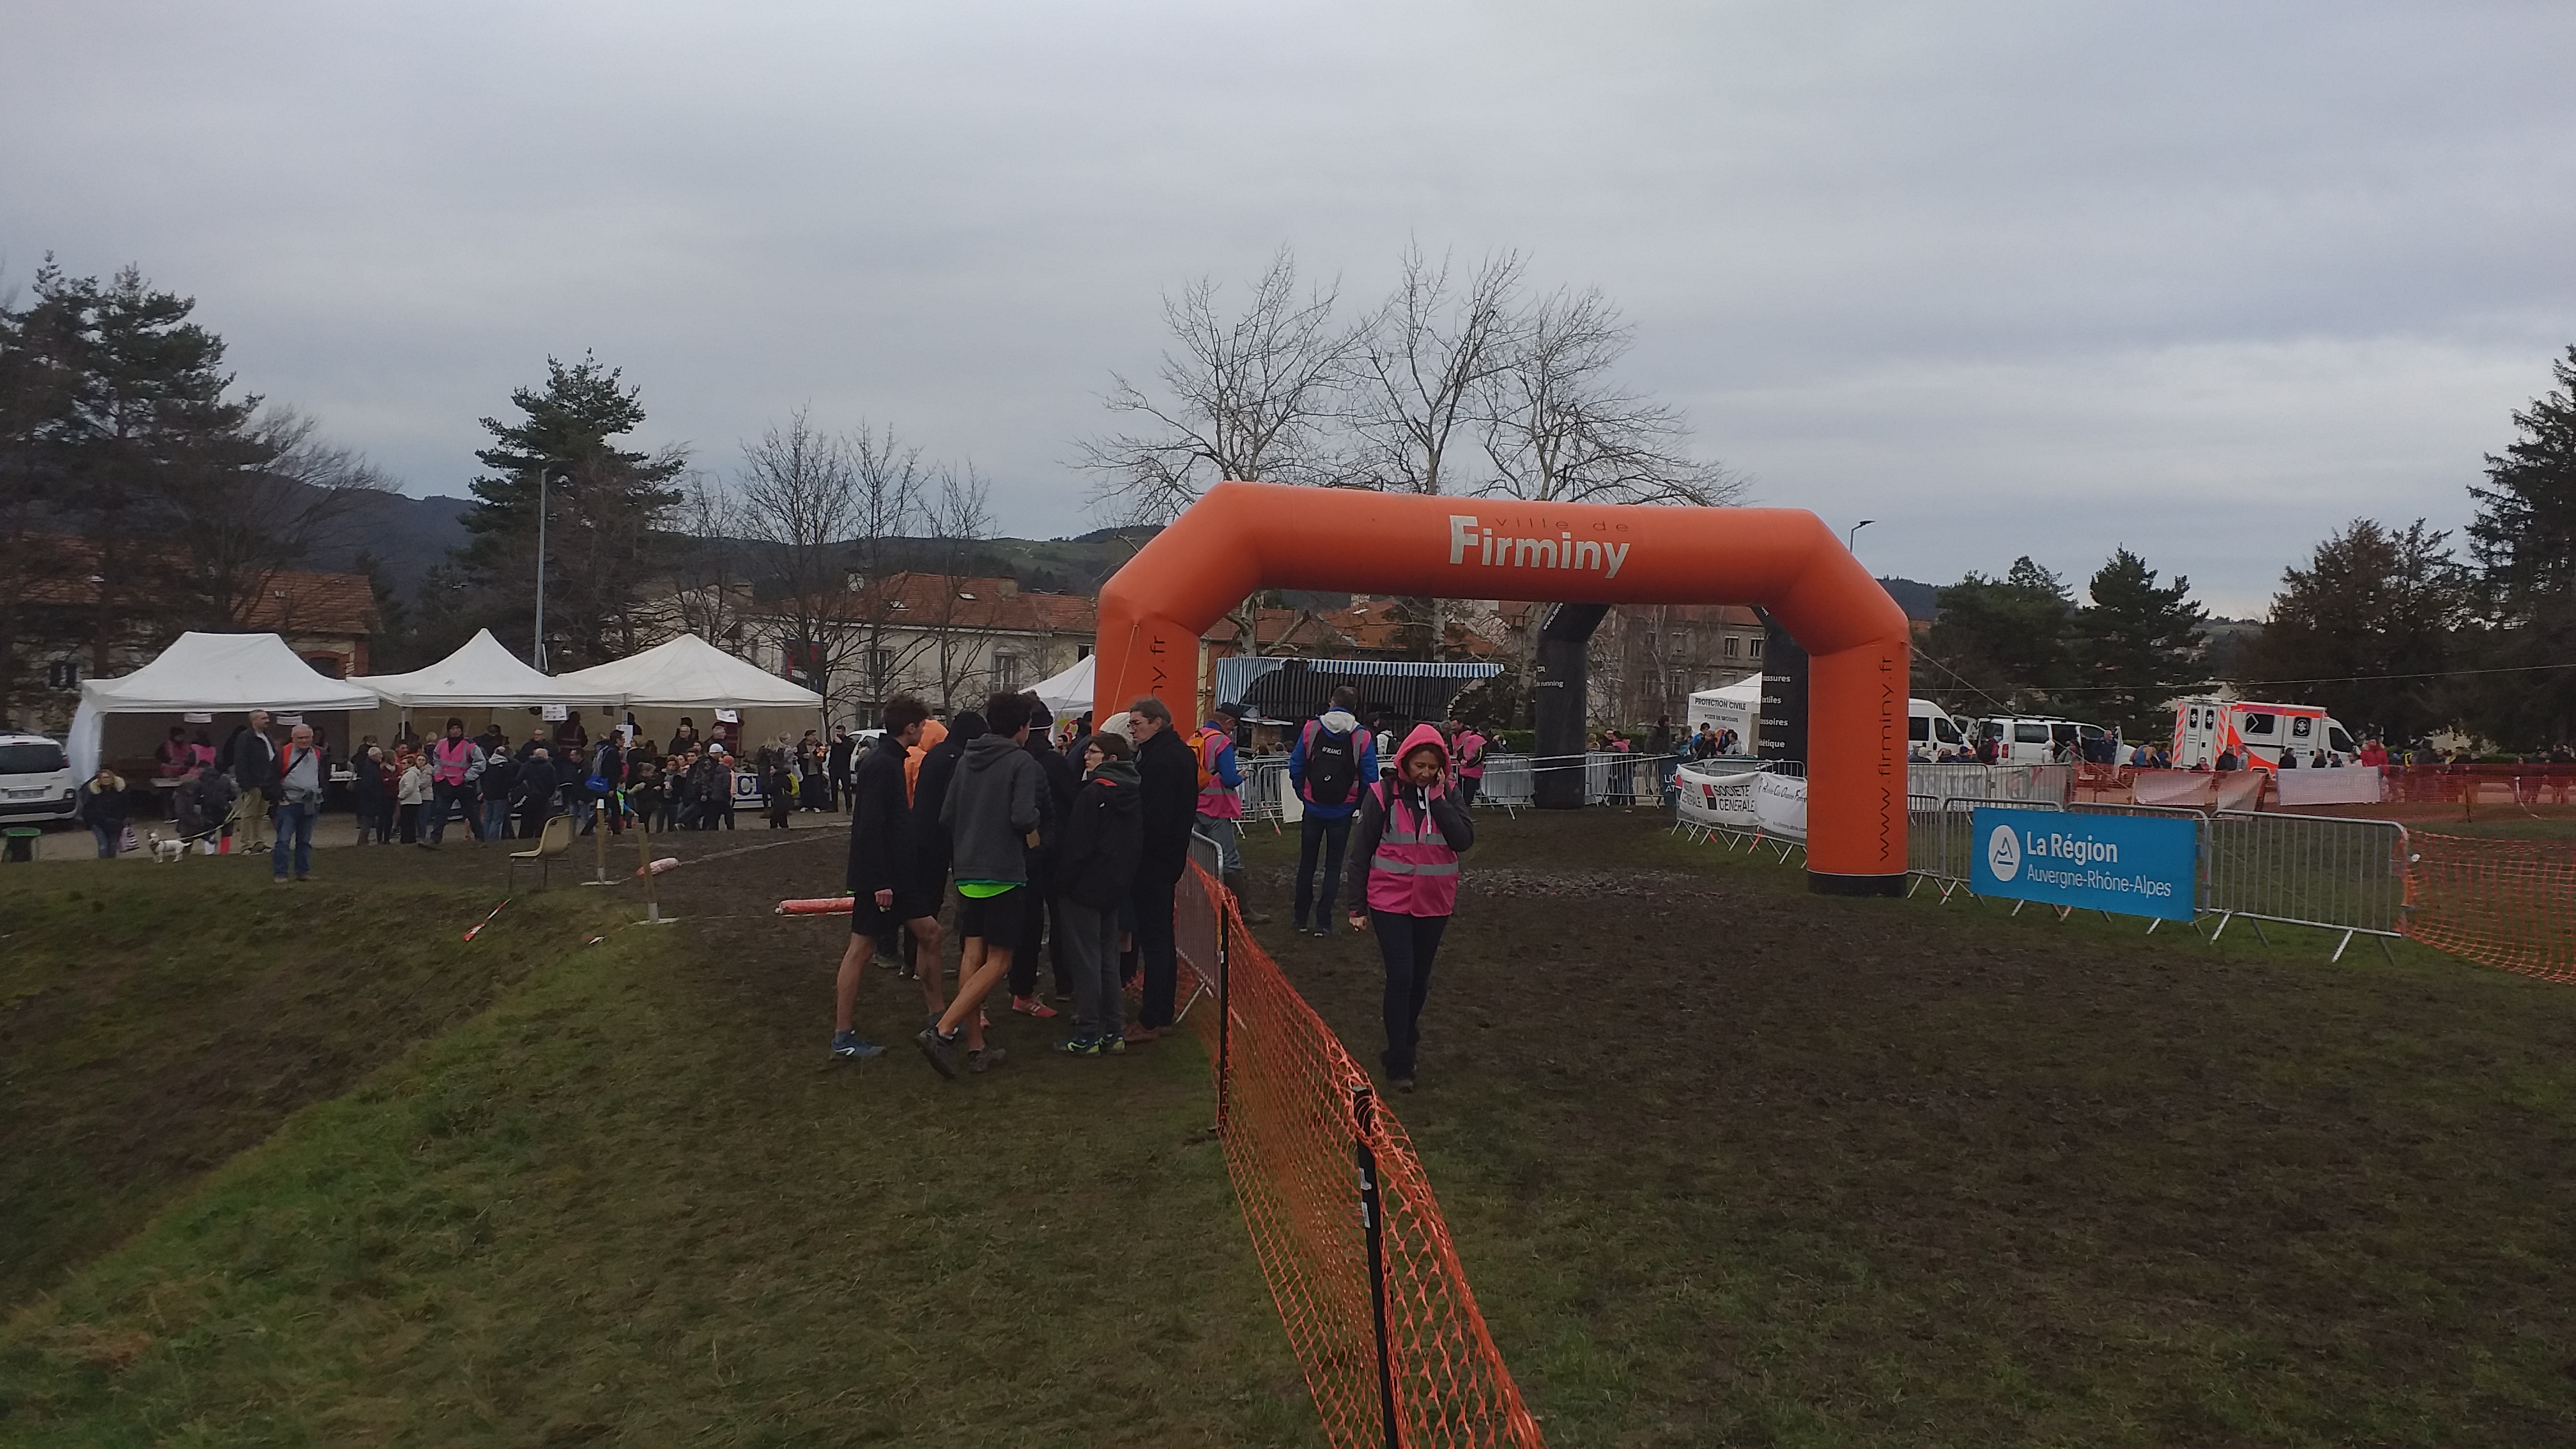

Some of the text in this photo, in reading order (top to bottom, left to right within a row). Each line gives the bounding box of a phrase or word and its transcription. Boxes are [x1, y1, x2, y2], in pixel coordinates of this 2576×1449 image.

[1496, 517, 1629, 532] ville de
[1449, 514, 1630, 579] Firminy
[1540, 679, 1564, 688] running
[1695, 698, 1746, 710] PROTECTION CIVILE
[1879, 655, 1894, 862] www.firminy.fr
[1713, 785, 1751, 797] SOCIETE
[2027, 831, 2118, 866] La Région
[2027, 864, 2172, 898] Auvergne-Rhône-Alpes
